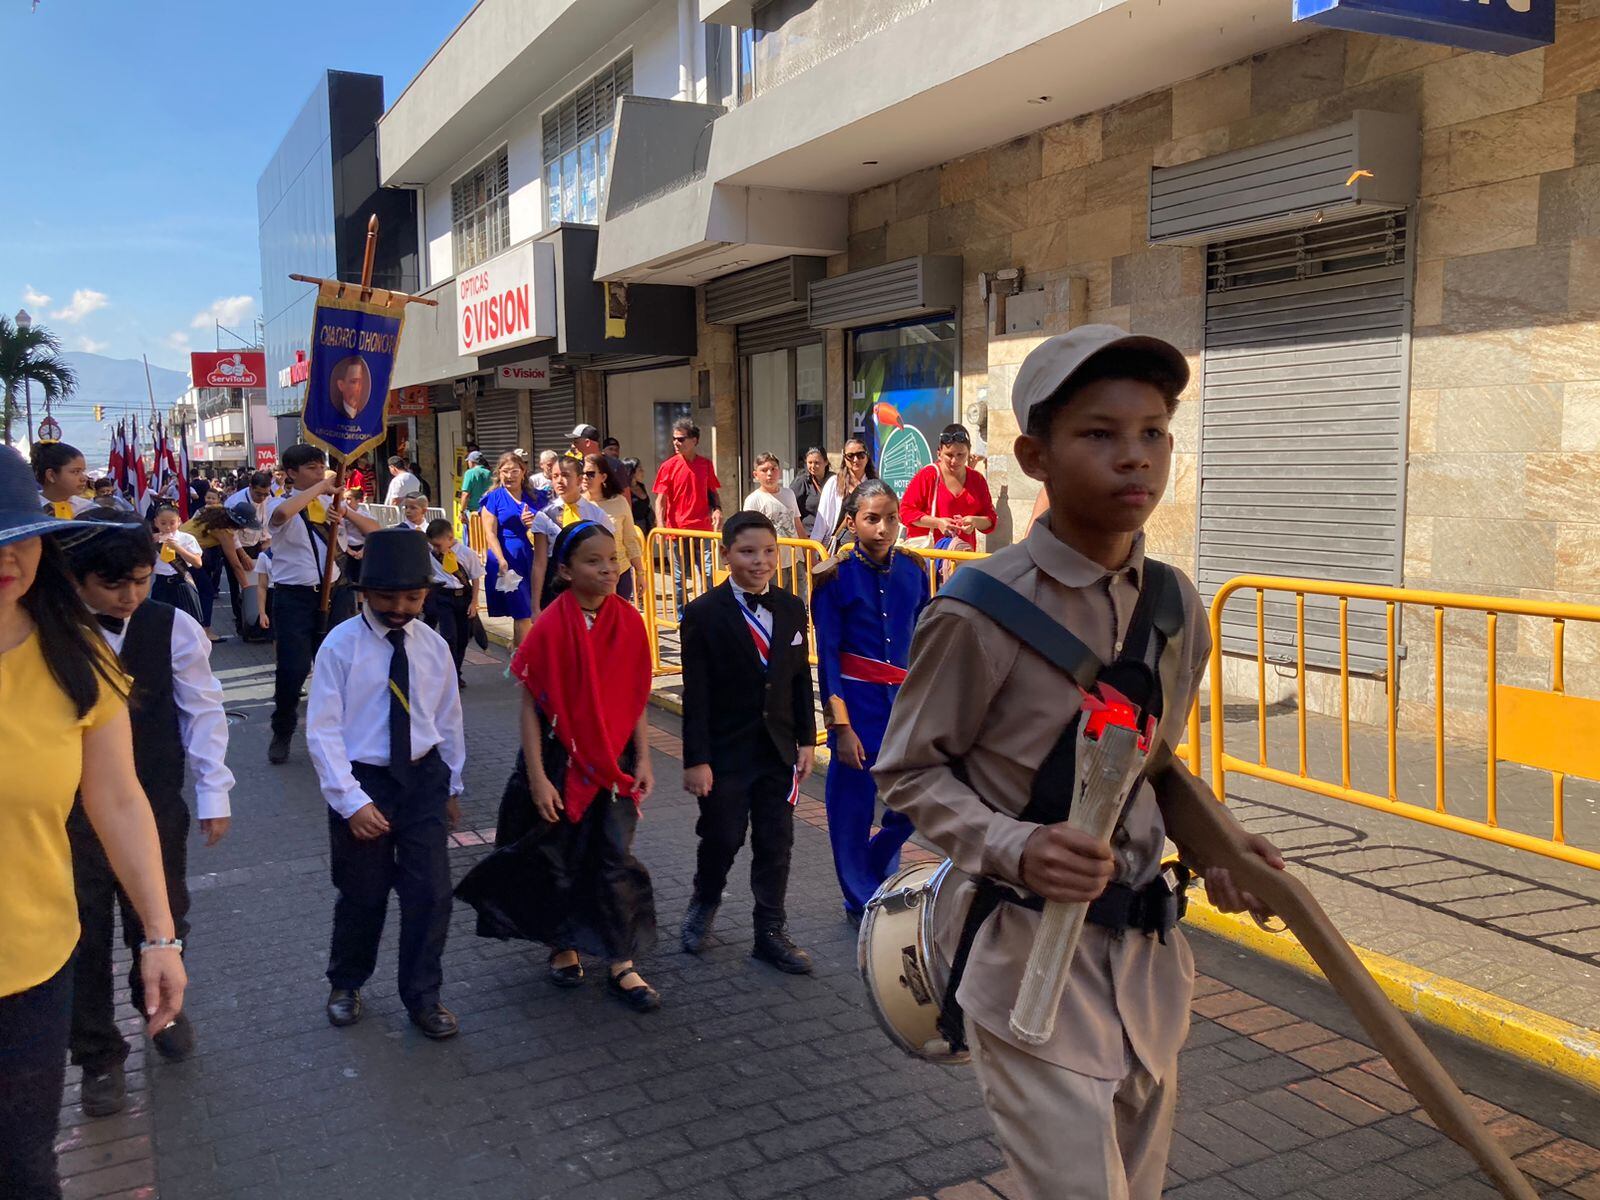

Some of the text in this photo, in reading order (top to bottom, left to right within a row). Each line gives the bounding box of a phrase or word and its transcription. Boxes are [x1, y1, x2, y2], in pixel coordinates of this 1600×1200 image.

[461, 271, 488, 299] OPTICAS
[473, 284, 530, 343] VISION
[211, 375, 253, 383] ServiTotal
